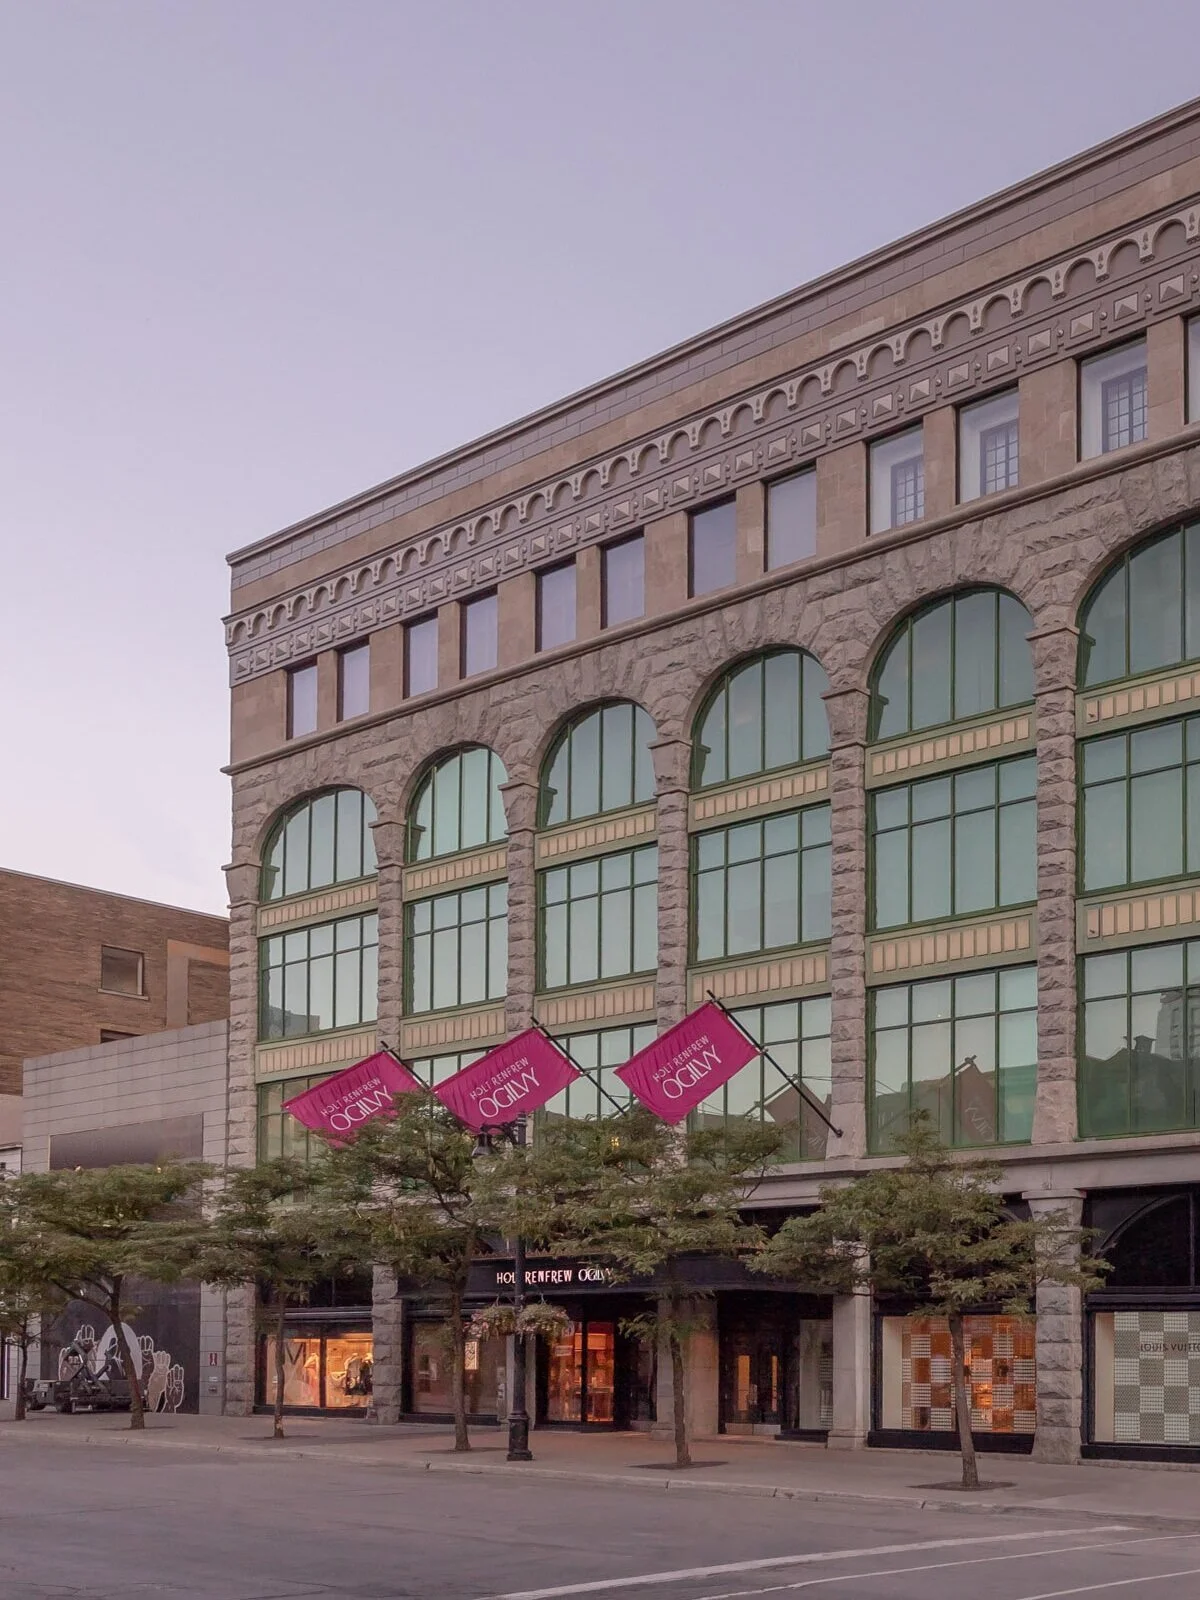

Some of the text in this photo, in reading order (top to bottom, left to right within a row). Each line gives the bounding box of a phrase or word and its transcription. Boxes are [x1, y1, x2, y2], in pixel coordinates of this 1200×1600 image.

[470, 1056, 529, 1101] HOLT RENFREW
[652, 1035, 709, 1082] HOLT RENFREW
[662, 1044, 722, 1099] OGILVY
[320, 1077, 381, 1117] HOLT RENFREW
[330, 1085, 393, 1130] OGILVY
[478, 1066, 540, 1118] OGILVY
[496, 1272, 516, 1284] HOL
[525, 1269, 573, 1285] RENFREW
[1140, 1343, 1169, 1352] LOUIS
